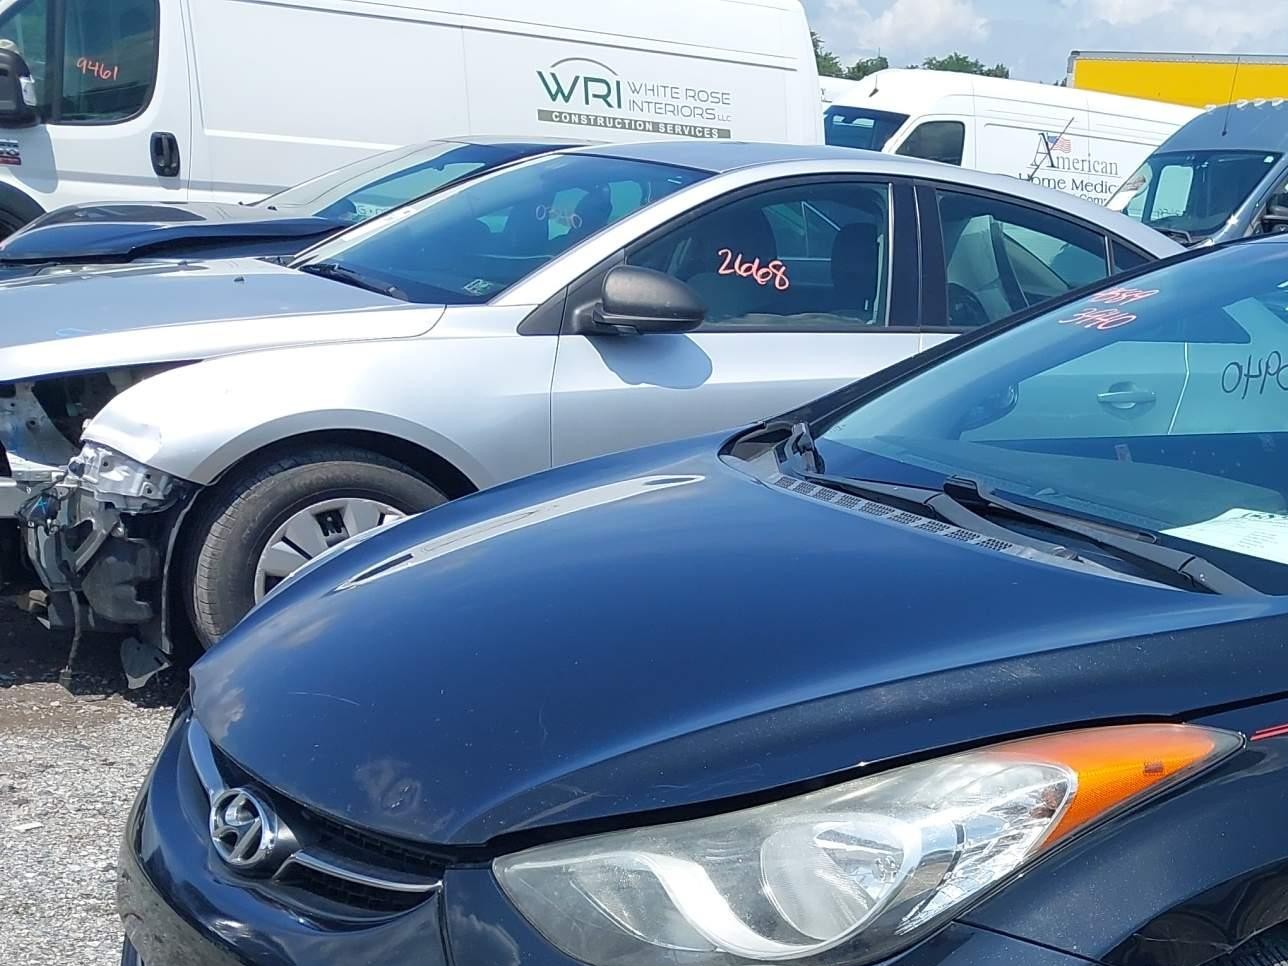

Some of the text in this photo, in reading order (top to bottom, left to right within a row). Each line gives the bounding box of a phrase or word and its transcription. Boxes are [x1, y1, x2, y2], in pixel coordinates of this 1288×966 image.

[76, 56, 119, 81] 9461
[536, 70, 622, 110] WRI
[627, 81, 731, 106] WHITE ROSE
[628, 99, 732, 122] INTERIORS LLC
[552, 112, 719, 138] CONSTRUCTION SERVICES
[1030, 132, 1119, 176] American
[1071, 178, 1119, 194] Medic
[718, 248, 790, 291] 2668
